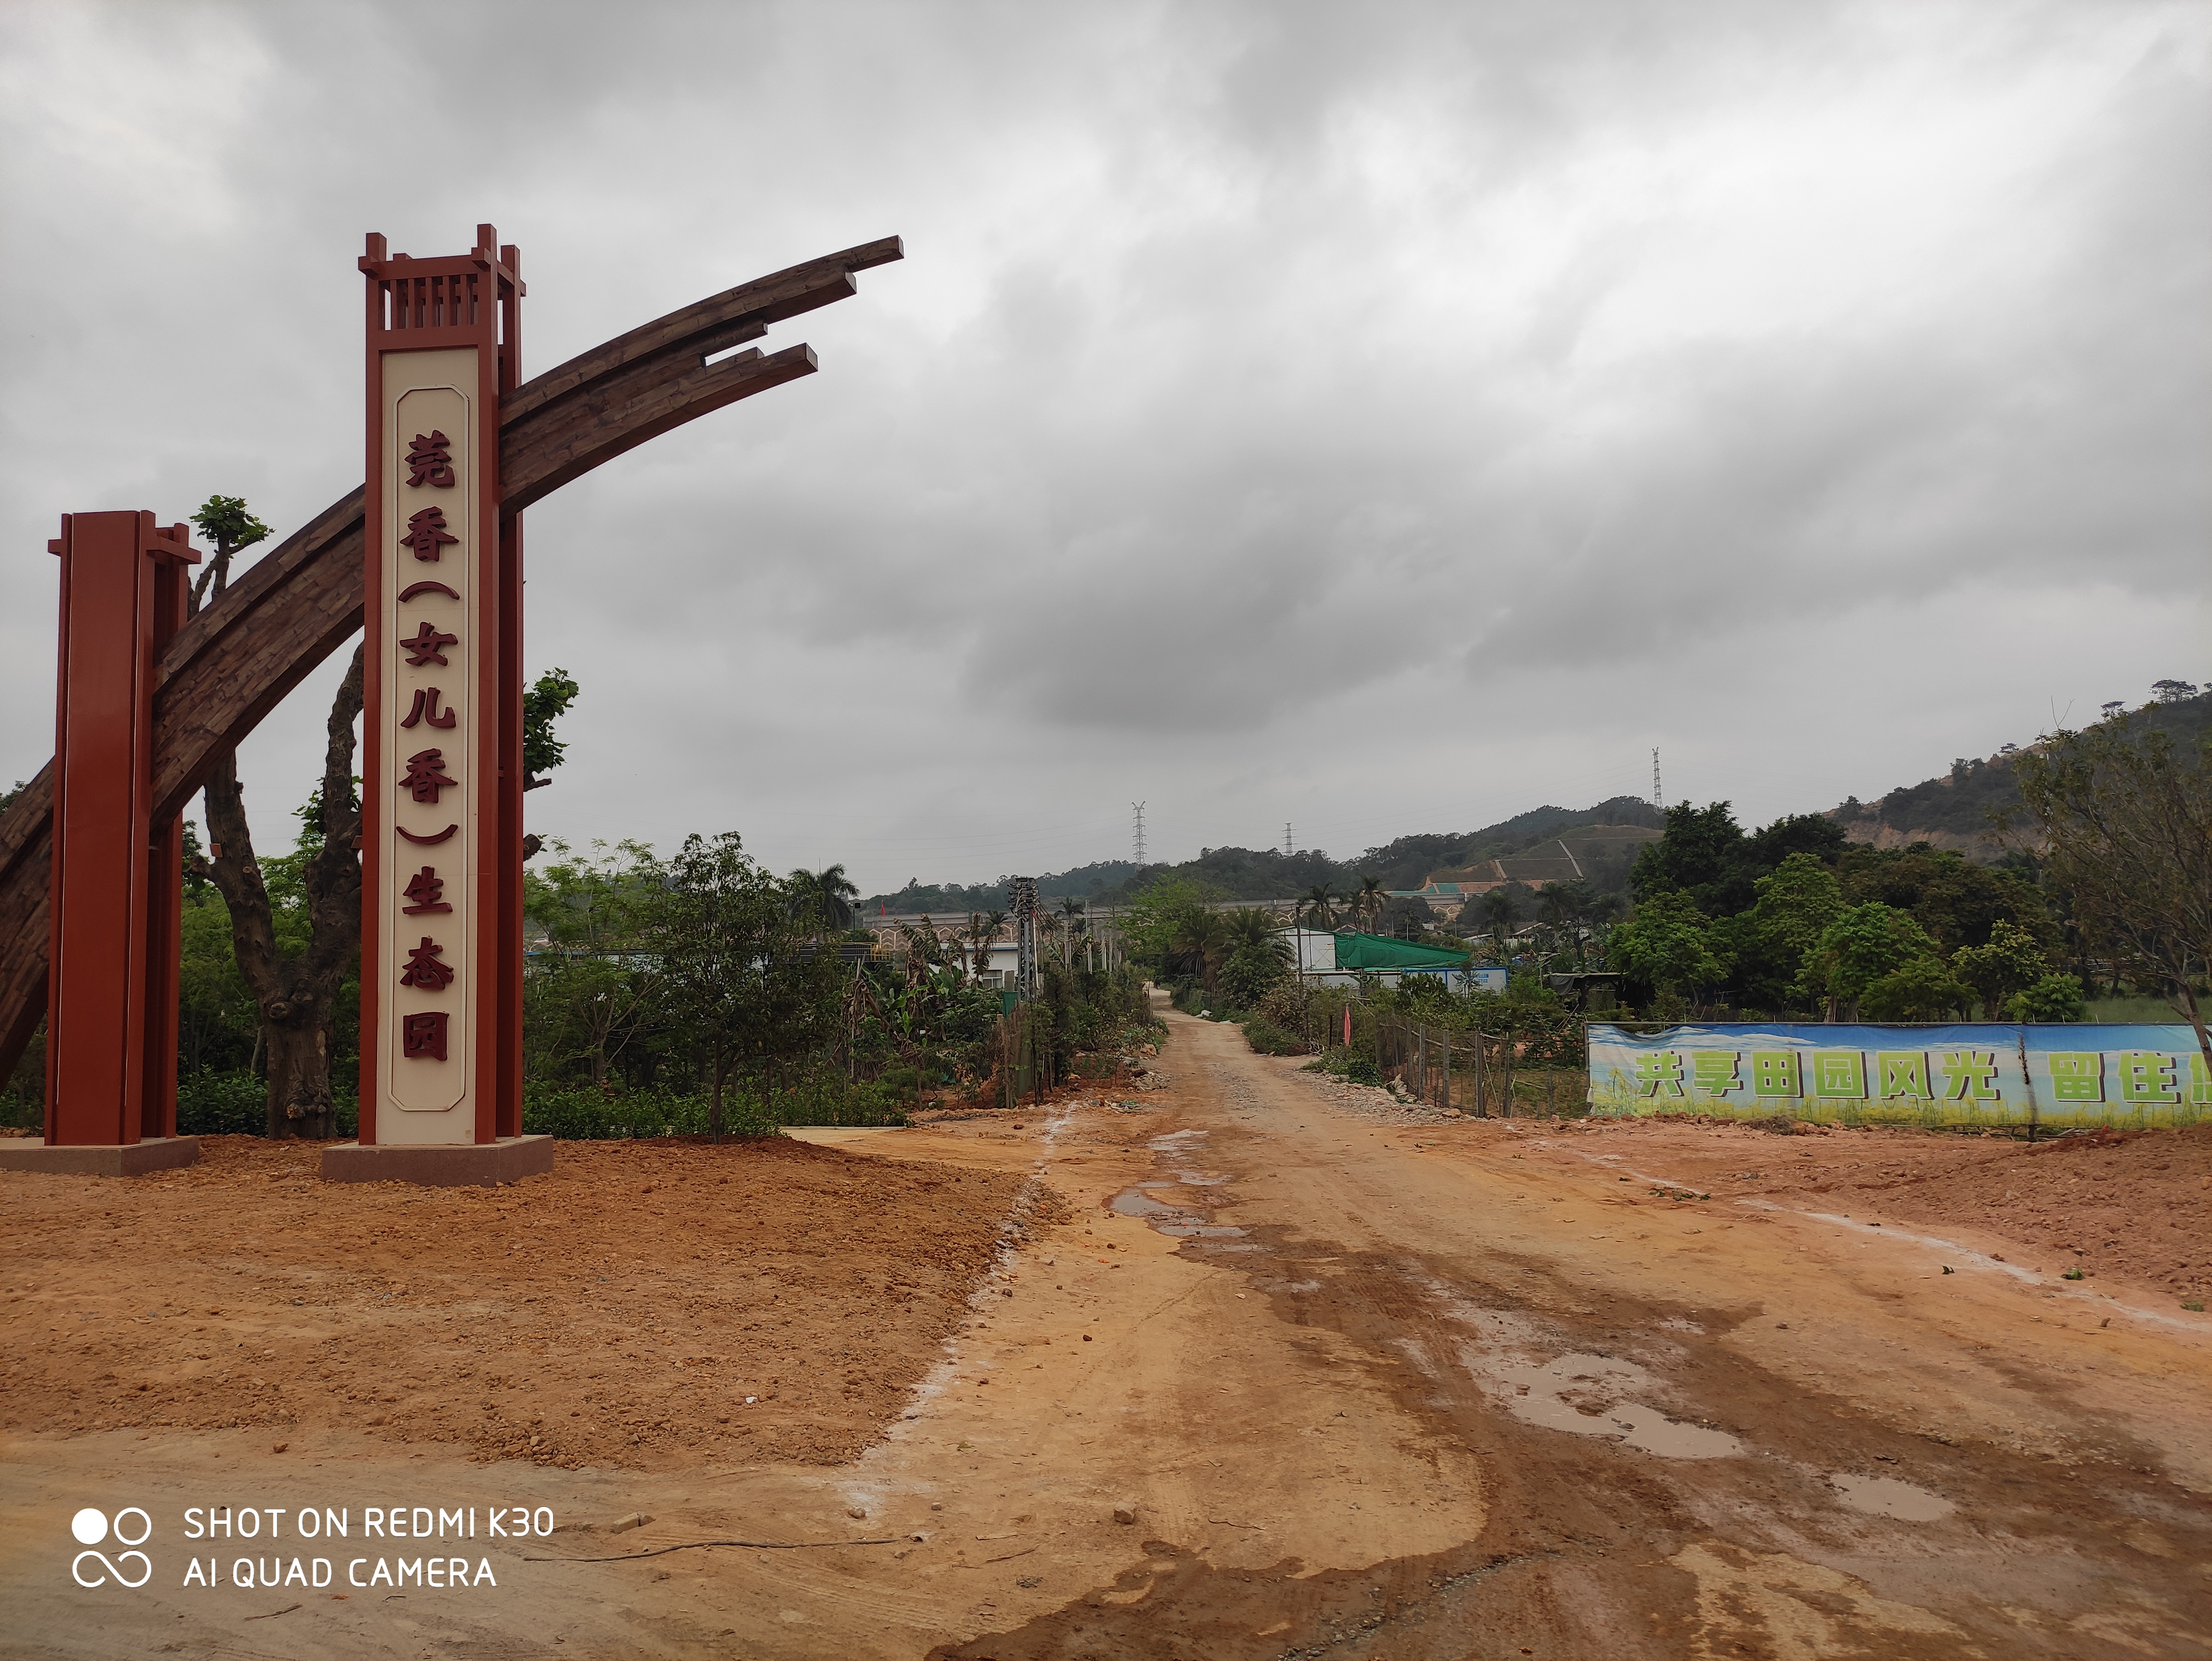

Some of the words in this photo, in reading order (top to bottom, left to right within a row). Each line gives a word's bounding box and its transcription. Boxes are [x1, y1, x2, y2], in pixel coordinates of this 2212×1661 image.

[1634, 1051, 2000, 1101] 共享田园风光
